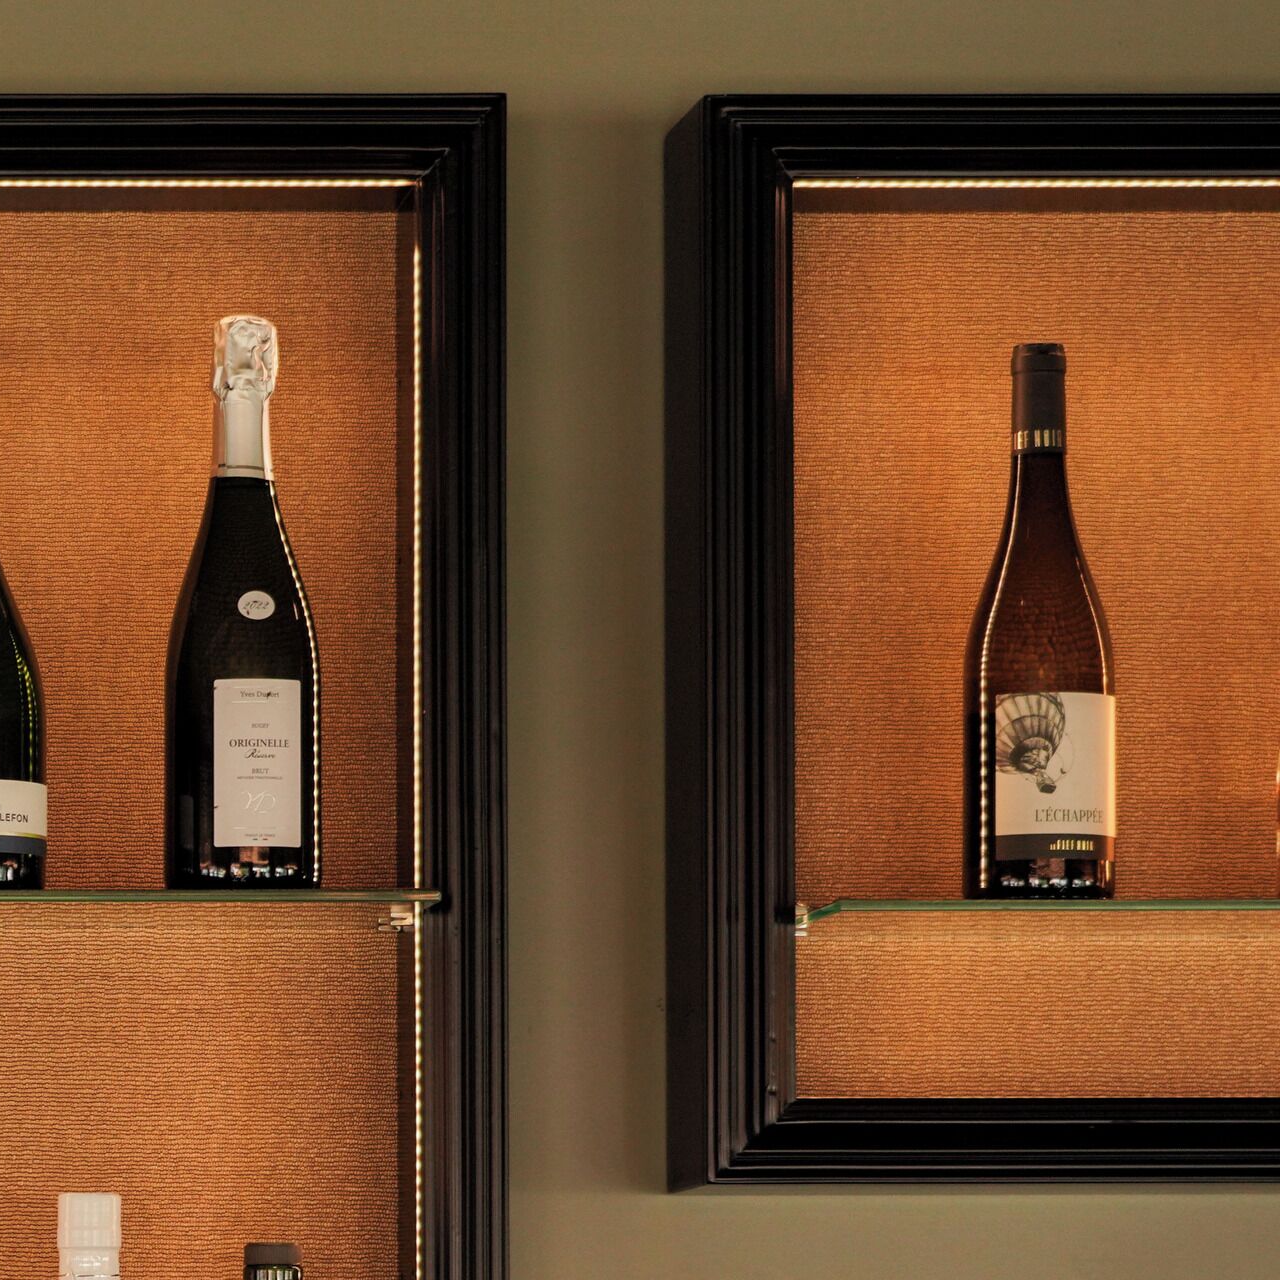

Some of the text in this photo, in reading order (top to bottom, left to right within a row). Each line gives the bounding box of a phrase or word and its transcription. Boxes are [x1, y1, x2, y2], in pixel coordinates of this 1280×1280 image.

[1014, 430, 1029, 450] IEF
[241, 690, 256, 698] Yves
[228, 738, 290, 748] ORIGINELLE
[1035, 806, 1104, 824] L'ÉCHAPPÉE
